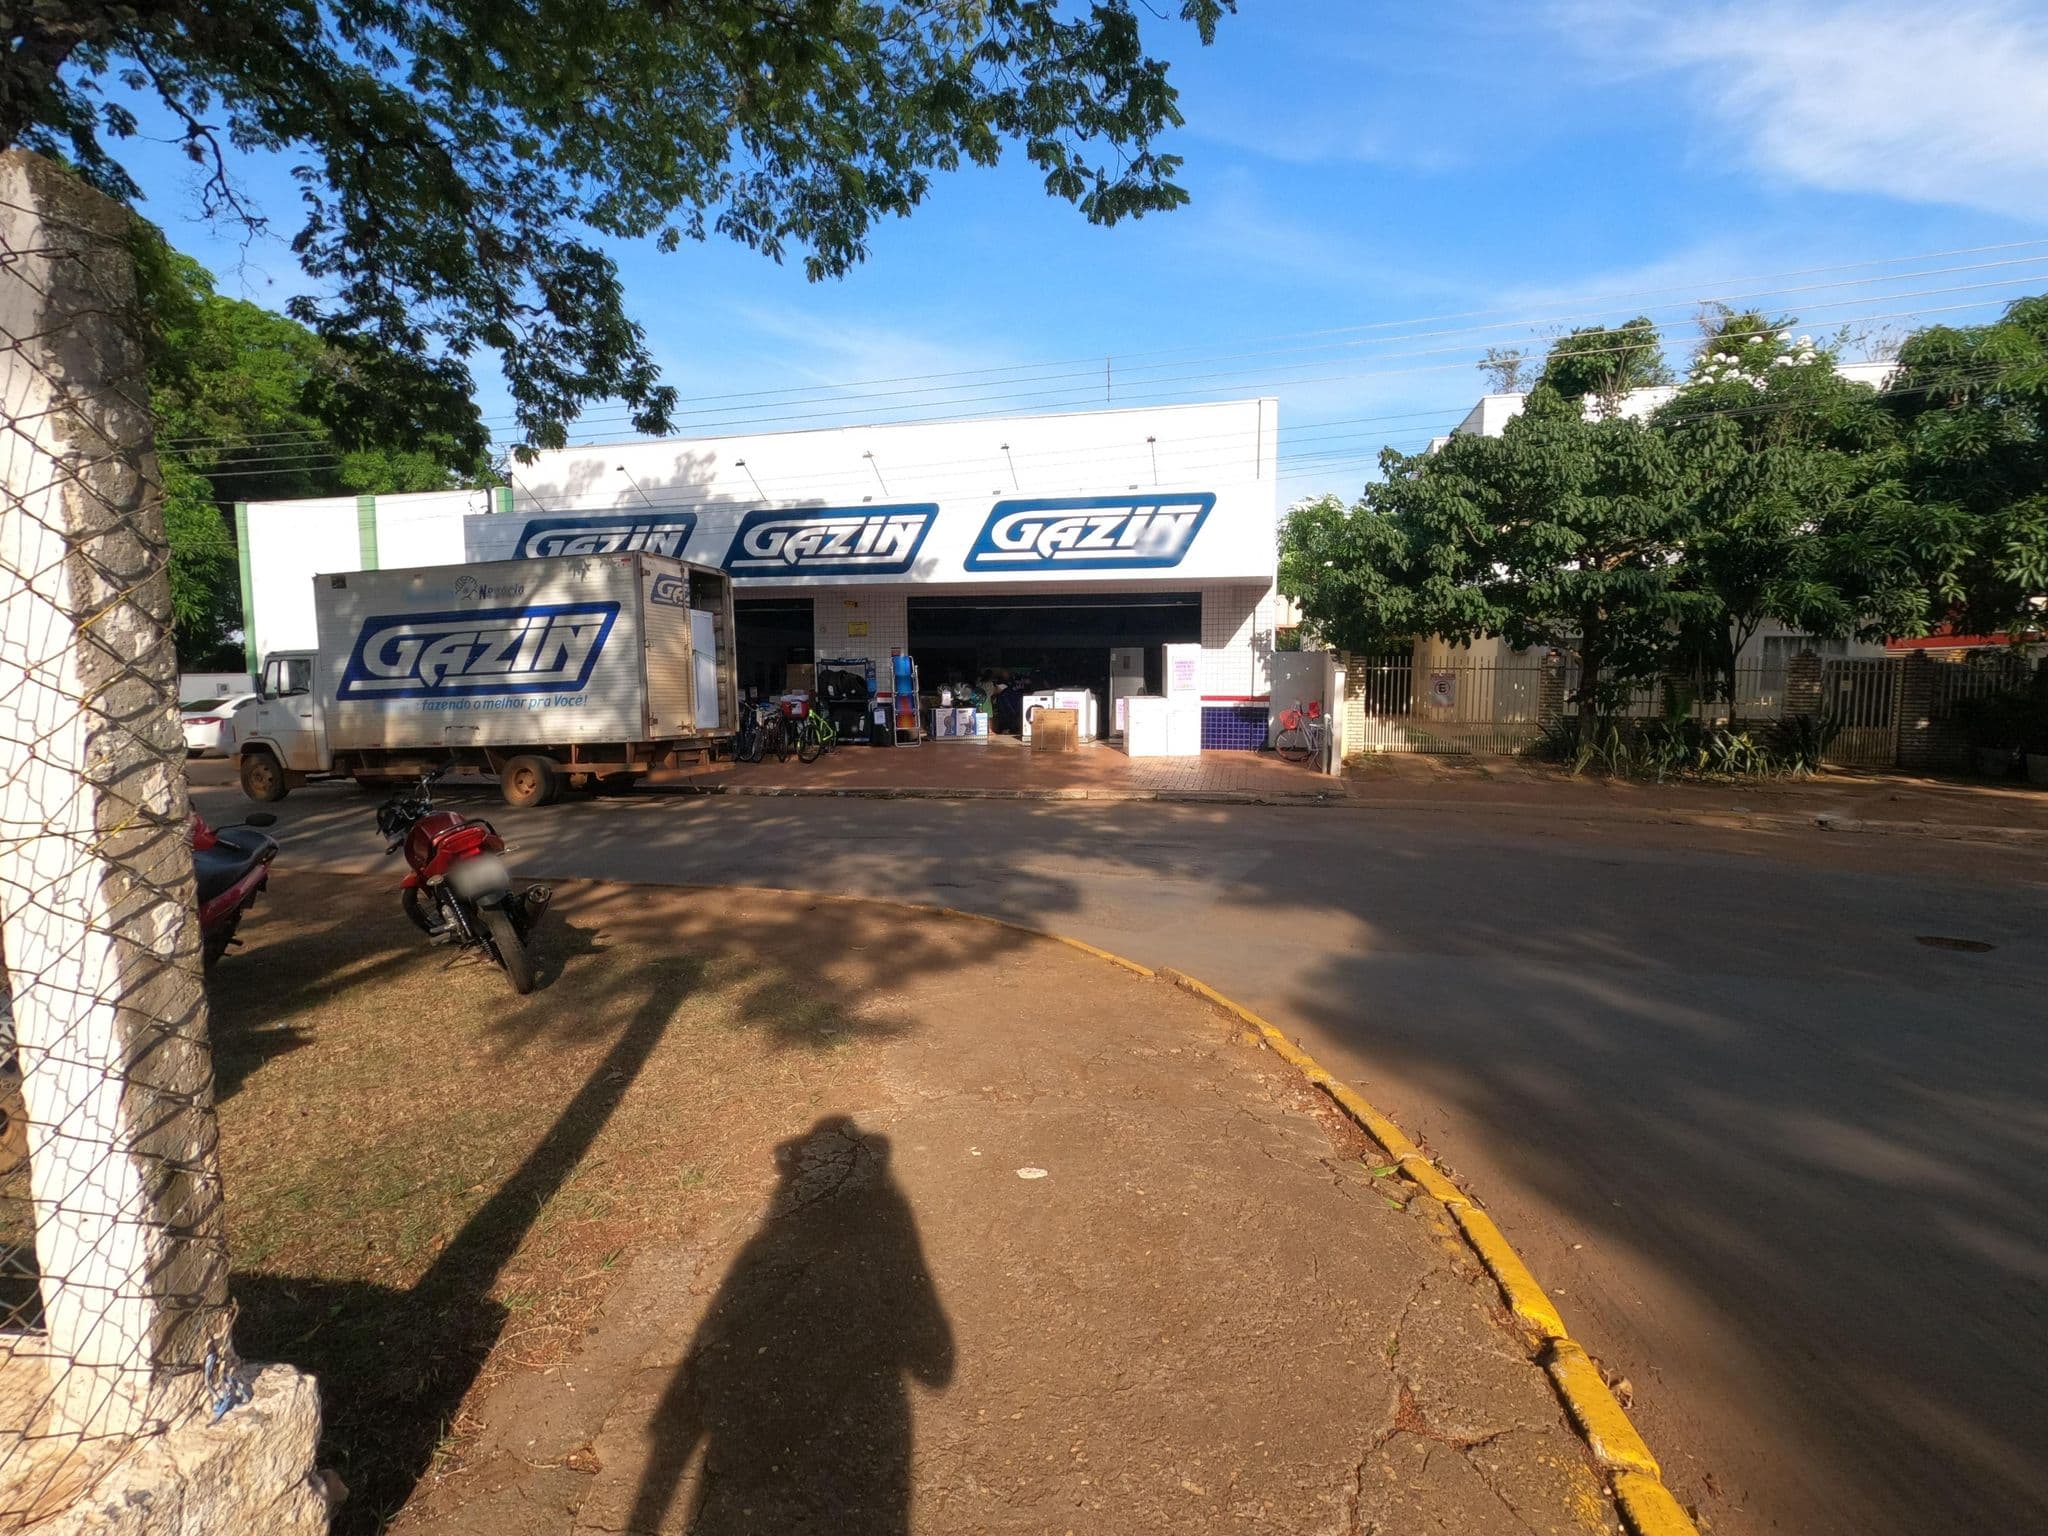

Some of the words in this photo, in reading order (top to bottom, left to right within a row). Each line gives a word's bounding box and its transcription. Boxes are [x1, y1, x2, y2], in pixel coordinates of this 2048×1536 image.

[743, 513, 928, 565] GAZIN
[990, 503, 1203, 560] GAZIN
[362, 612, 608, 688] GAZIN
[421, 698, 470, 712] fazendo
[482, 696, 527, 710] melhor
